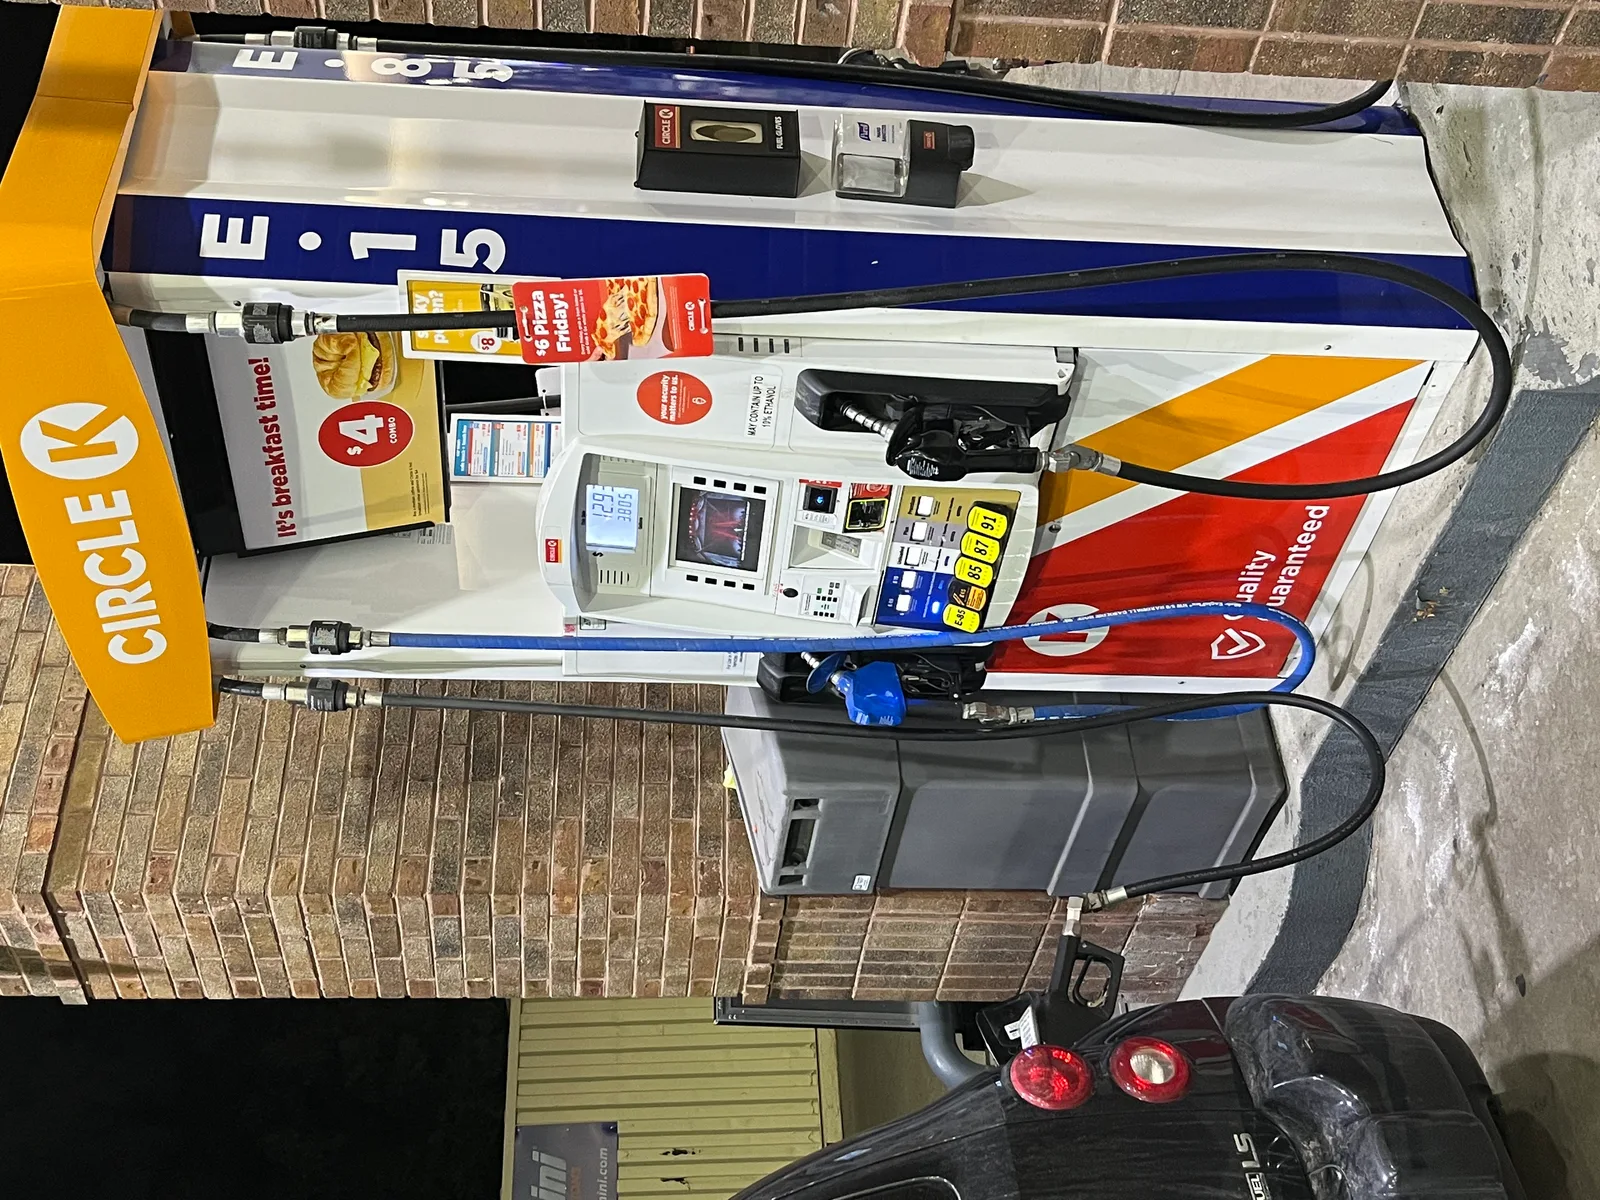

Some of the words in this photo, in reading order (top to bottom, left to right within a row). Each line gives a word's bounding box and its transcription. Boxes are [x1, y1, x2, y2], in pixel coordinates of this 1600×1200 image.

[658, 108, 674, 118] K
[774, 116, 782, 136] GLOVES
[661, 119, 671, 144] CIRCLE
[776, 136, 784, 149] FUEL
[532, 290, 550, 335] Pizza
[549, 293, 572, 352] Friday!
[534, 338, 550, 356] $6
[248, 356, 276, 411] time!
[660, 374, 671, 403] security
[670, 385, 678, 394] to
[752, 385, 762, 394] UP
[753, 375, 764, 384] TO
[660, 403, 669, 419] your
[669, 394, 677, 421] matters
[749, 395, 761, 422] CONTAIN
[763, 385, 776, 414] ETHANOL
[387, 416, 398, 443] COMBO
[747, 422, 757, 435] MAY
[762, 415, 772, 427] 10%
[22, 402, 136, 478] K
[339, 414, 384, 455] $4
[258, 414, 292, 507] breakfast
[276, 510, 296, 537] It's
[980, 515, 997, 530] 91
[974, 539, 989, 555] 87
[967, 564, 982, 580] 85
[1257, 505, 1330, 621] uaranteed
[64, 490, 168, 665] CIRCLE
[954, 609, 966, 626] E-85
[1233, 1132, 1260, 1167] LS
